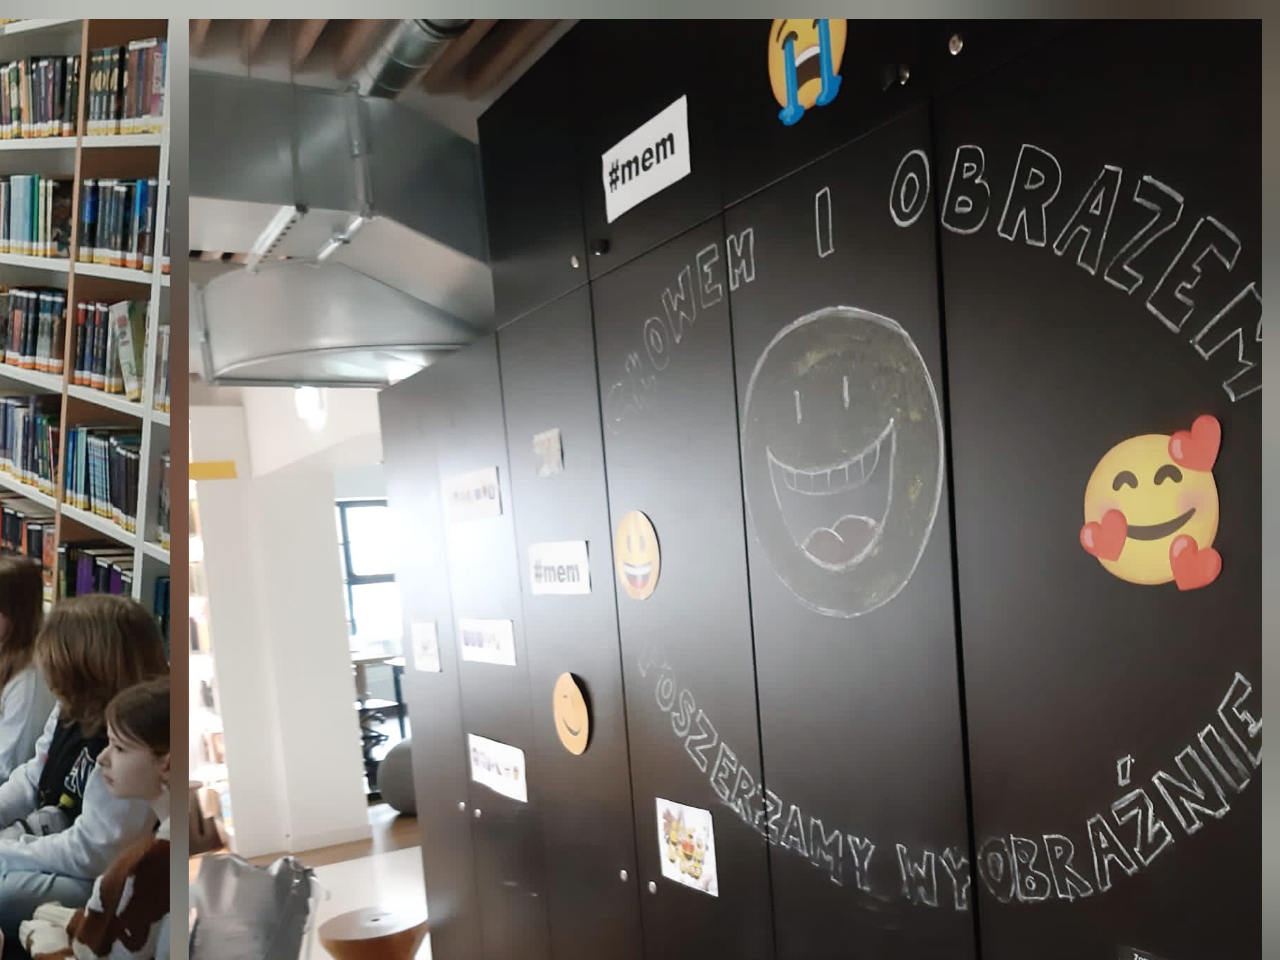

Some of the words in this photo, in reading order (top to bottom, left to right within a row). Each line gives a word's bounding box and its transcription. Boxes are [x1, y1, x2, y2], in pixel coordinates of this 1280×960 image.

[608, 132, 675, 193] #mem
[606, 227, 756, 436] OWEM
[815, 186, 835, 258] I
[533, 559, 581, 584] #mem
